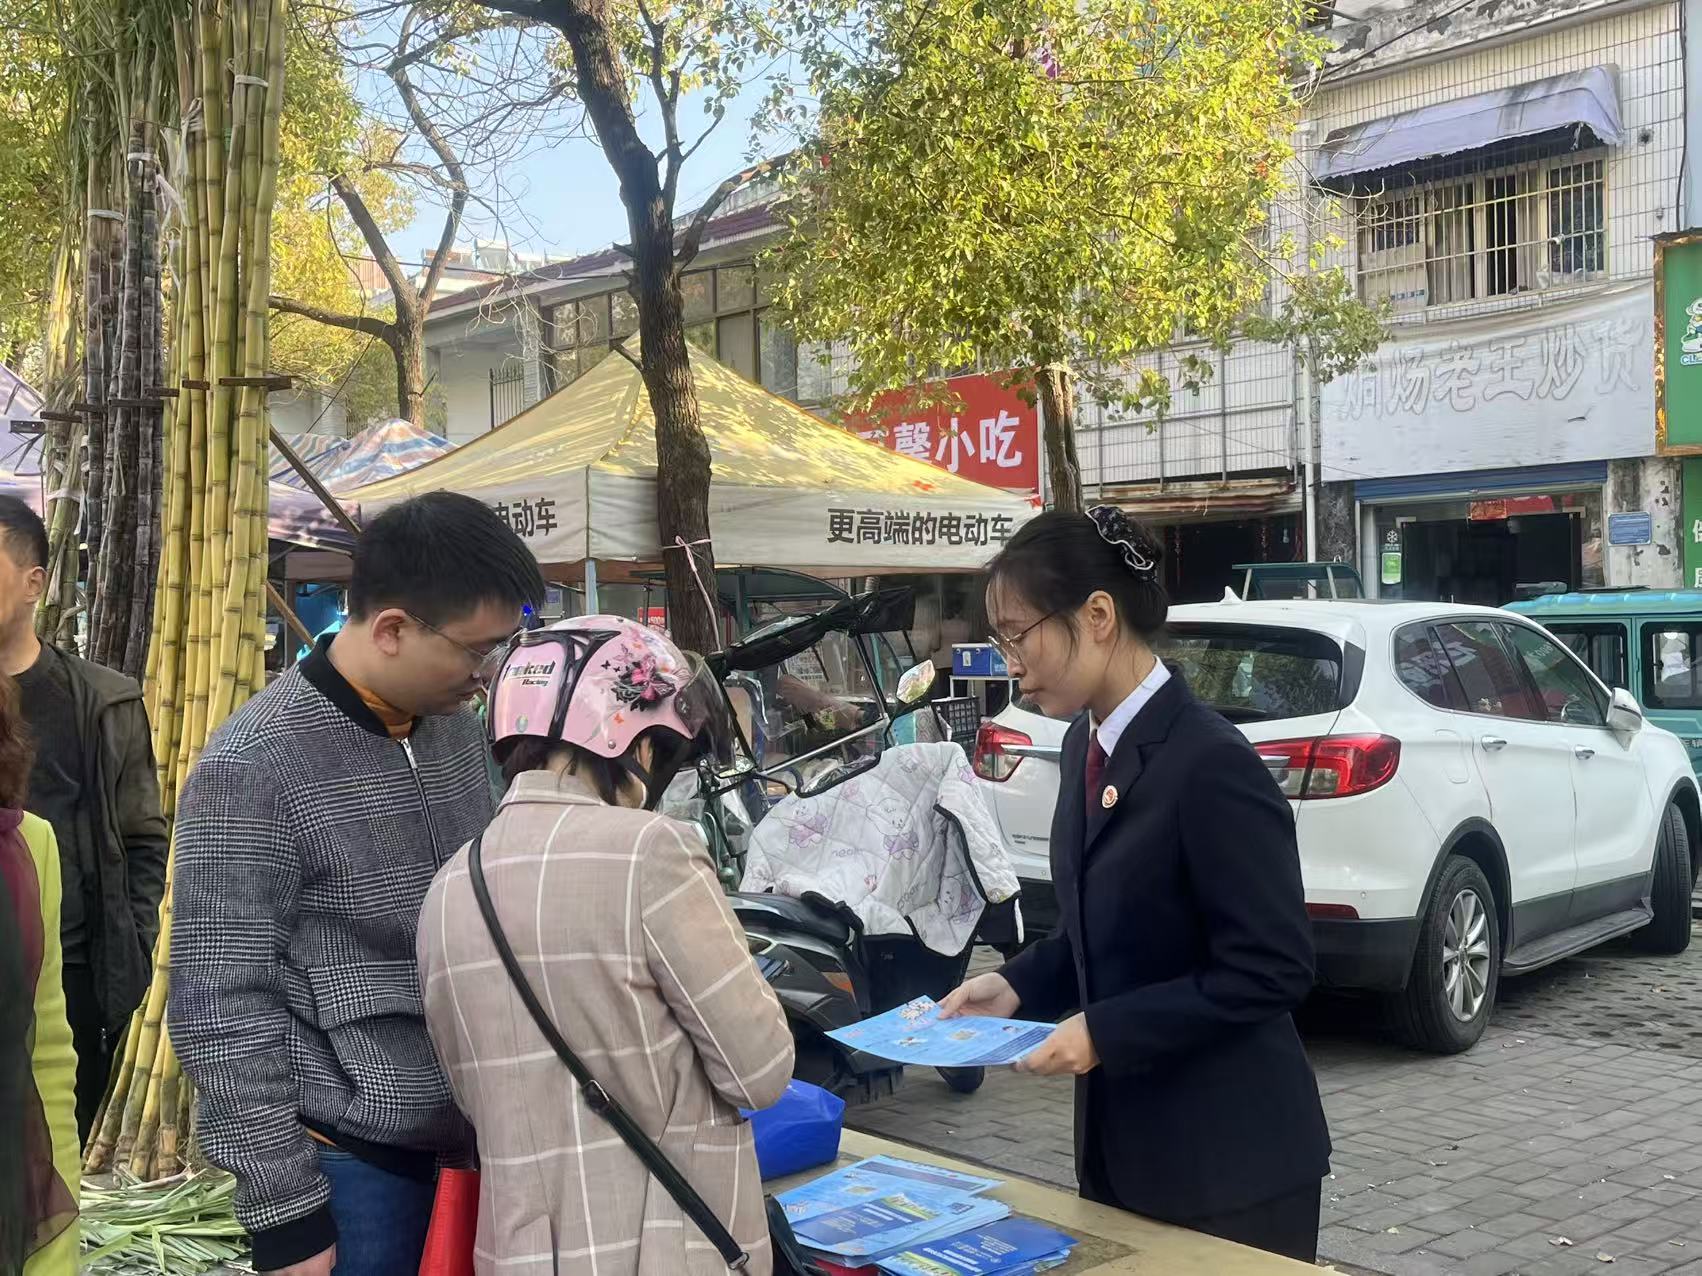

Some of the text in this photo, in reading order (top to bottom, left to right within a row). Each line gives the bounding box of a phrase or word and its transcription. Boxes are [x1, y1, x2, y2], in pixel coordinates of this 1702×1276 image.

[826, 508, 1014, 547] 更高端的电动车
